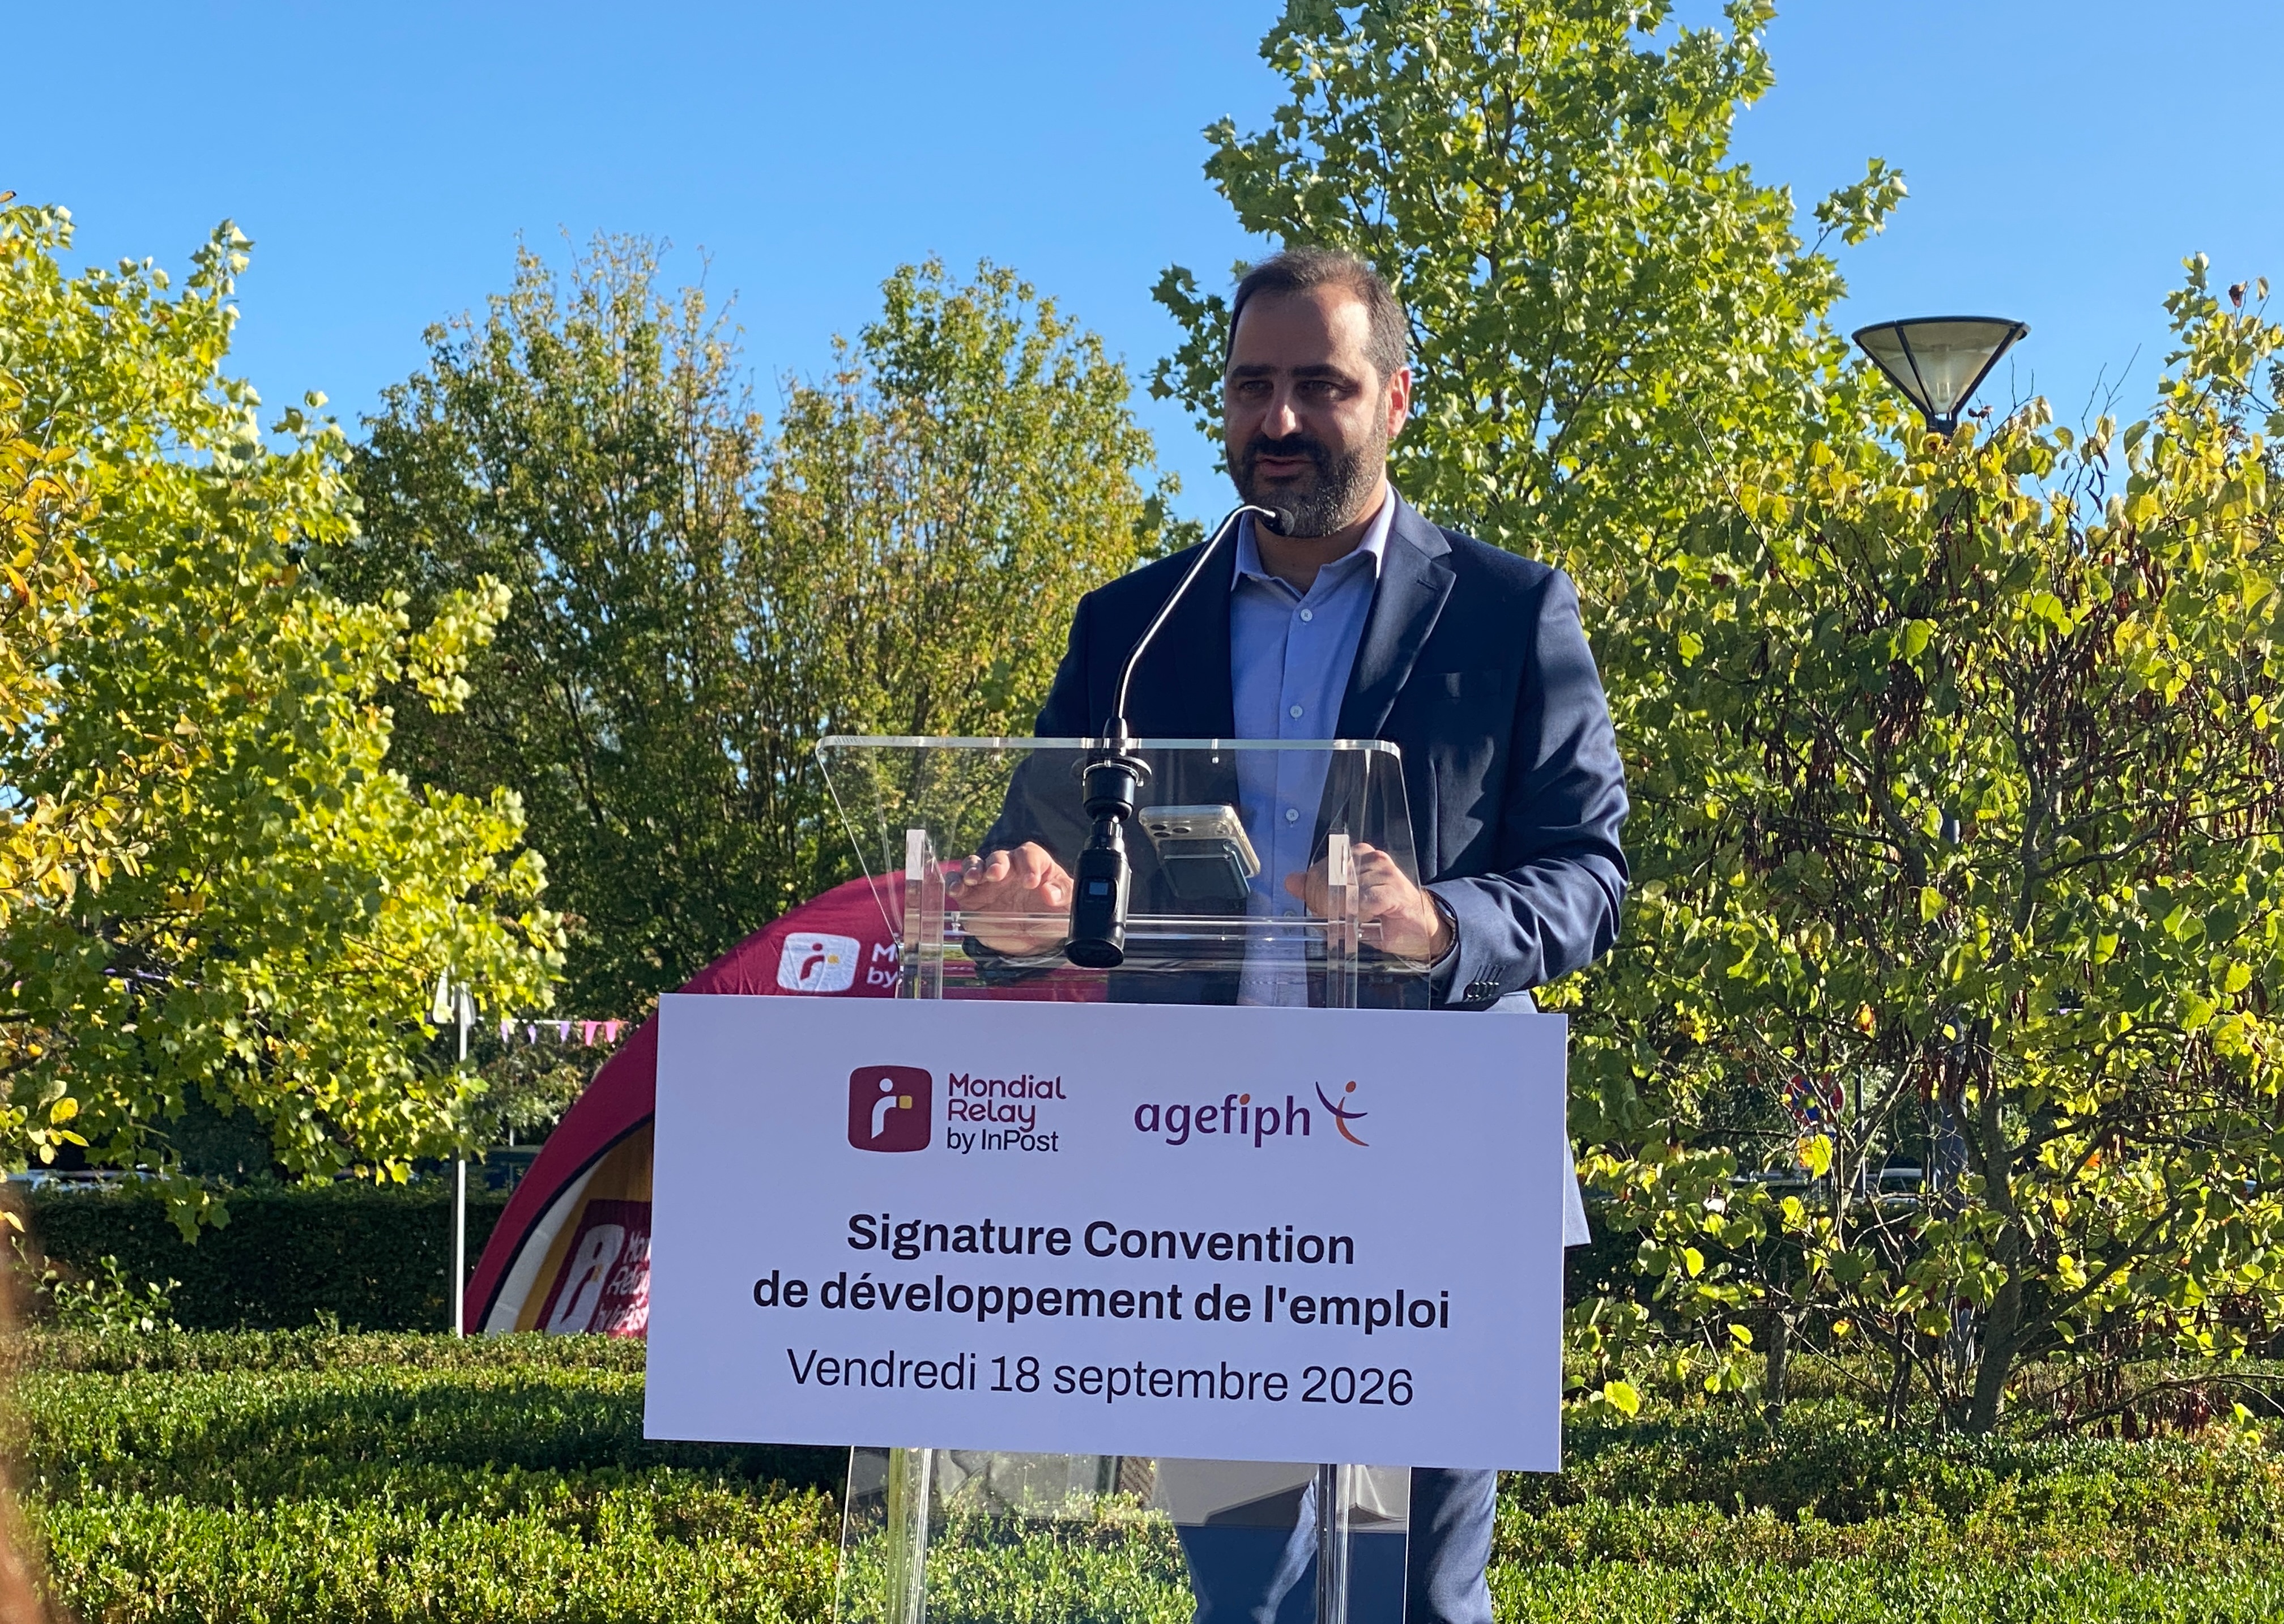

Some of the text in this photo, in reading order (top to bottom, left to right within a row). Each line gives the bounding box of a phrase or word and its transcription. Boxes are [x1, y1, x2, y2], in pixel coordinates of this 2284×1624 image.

[948, 1072, 1067, 1100] Mondial
[947, 1098, 1037, 1134] Relay
[947, 1126, 1059, 1156] by InPost
[1134, 1092, 1311, 1149] agefiph
[846, 1212, 1354, 1265] Signature Convention
[753, 1269, 1450, 1335] de développement de l'emploi
[786, 1348, 1414, 1406] Vendredi 18 septembre 2026
